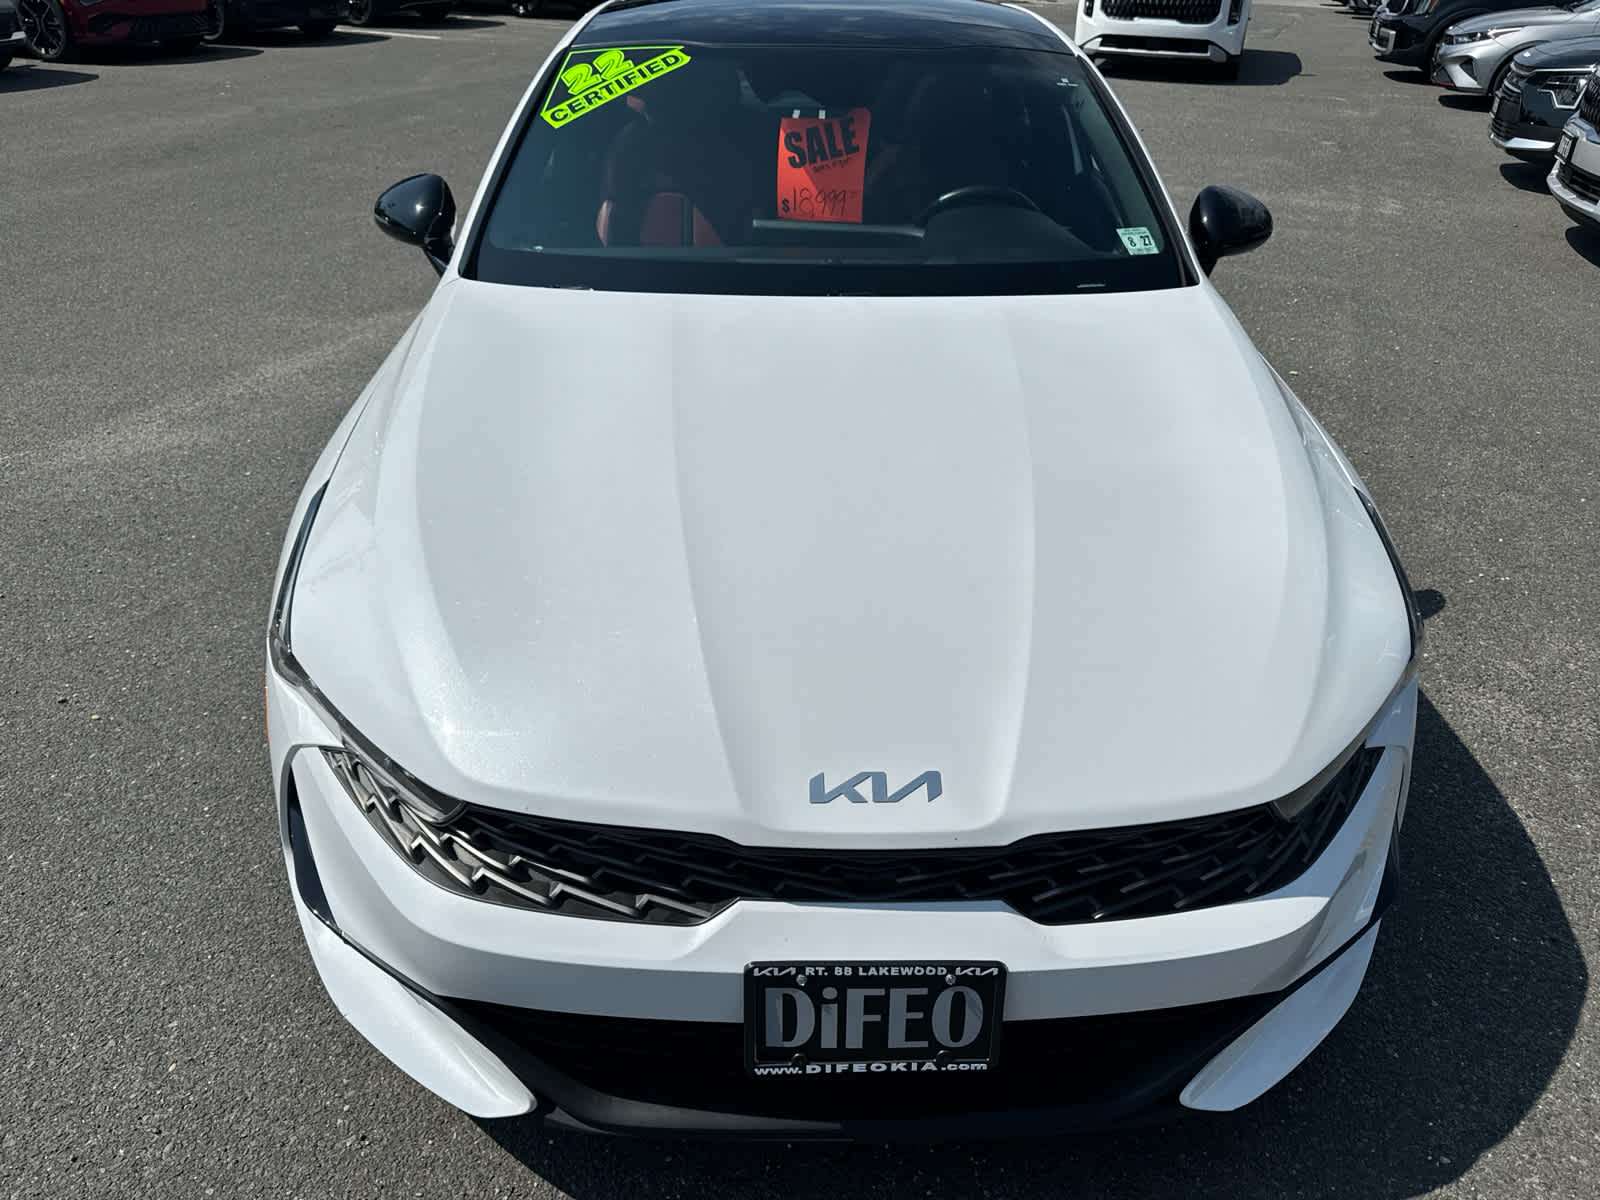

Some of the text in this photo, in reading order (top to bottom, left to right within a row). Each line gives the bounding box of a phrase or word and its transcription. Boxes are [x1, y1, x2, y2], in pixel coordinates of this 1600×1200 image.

[550, 54, 680, 122] CERTIFIED
[561, 50, 634, 95] 22
[784, 117, 860, 168] SALE
[1127, 235, 1152, 247] 8 27
[809, 770, 943, 804] KIA
[753, 967, 797, 976] KIA
[805, 966, 828, 976] RT.
[858, 966, 947, 976] LAKEWOOD
[955, 967, 999, 976] KIA
[764, 986, 984, 1049] DiFEO
[754, 1062, 988, 1076] www.DIFEOKIA.com
